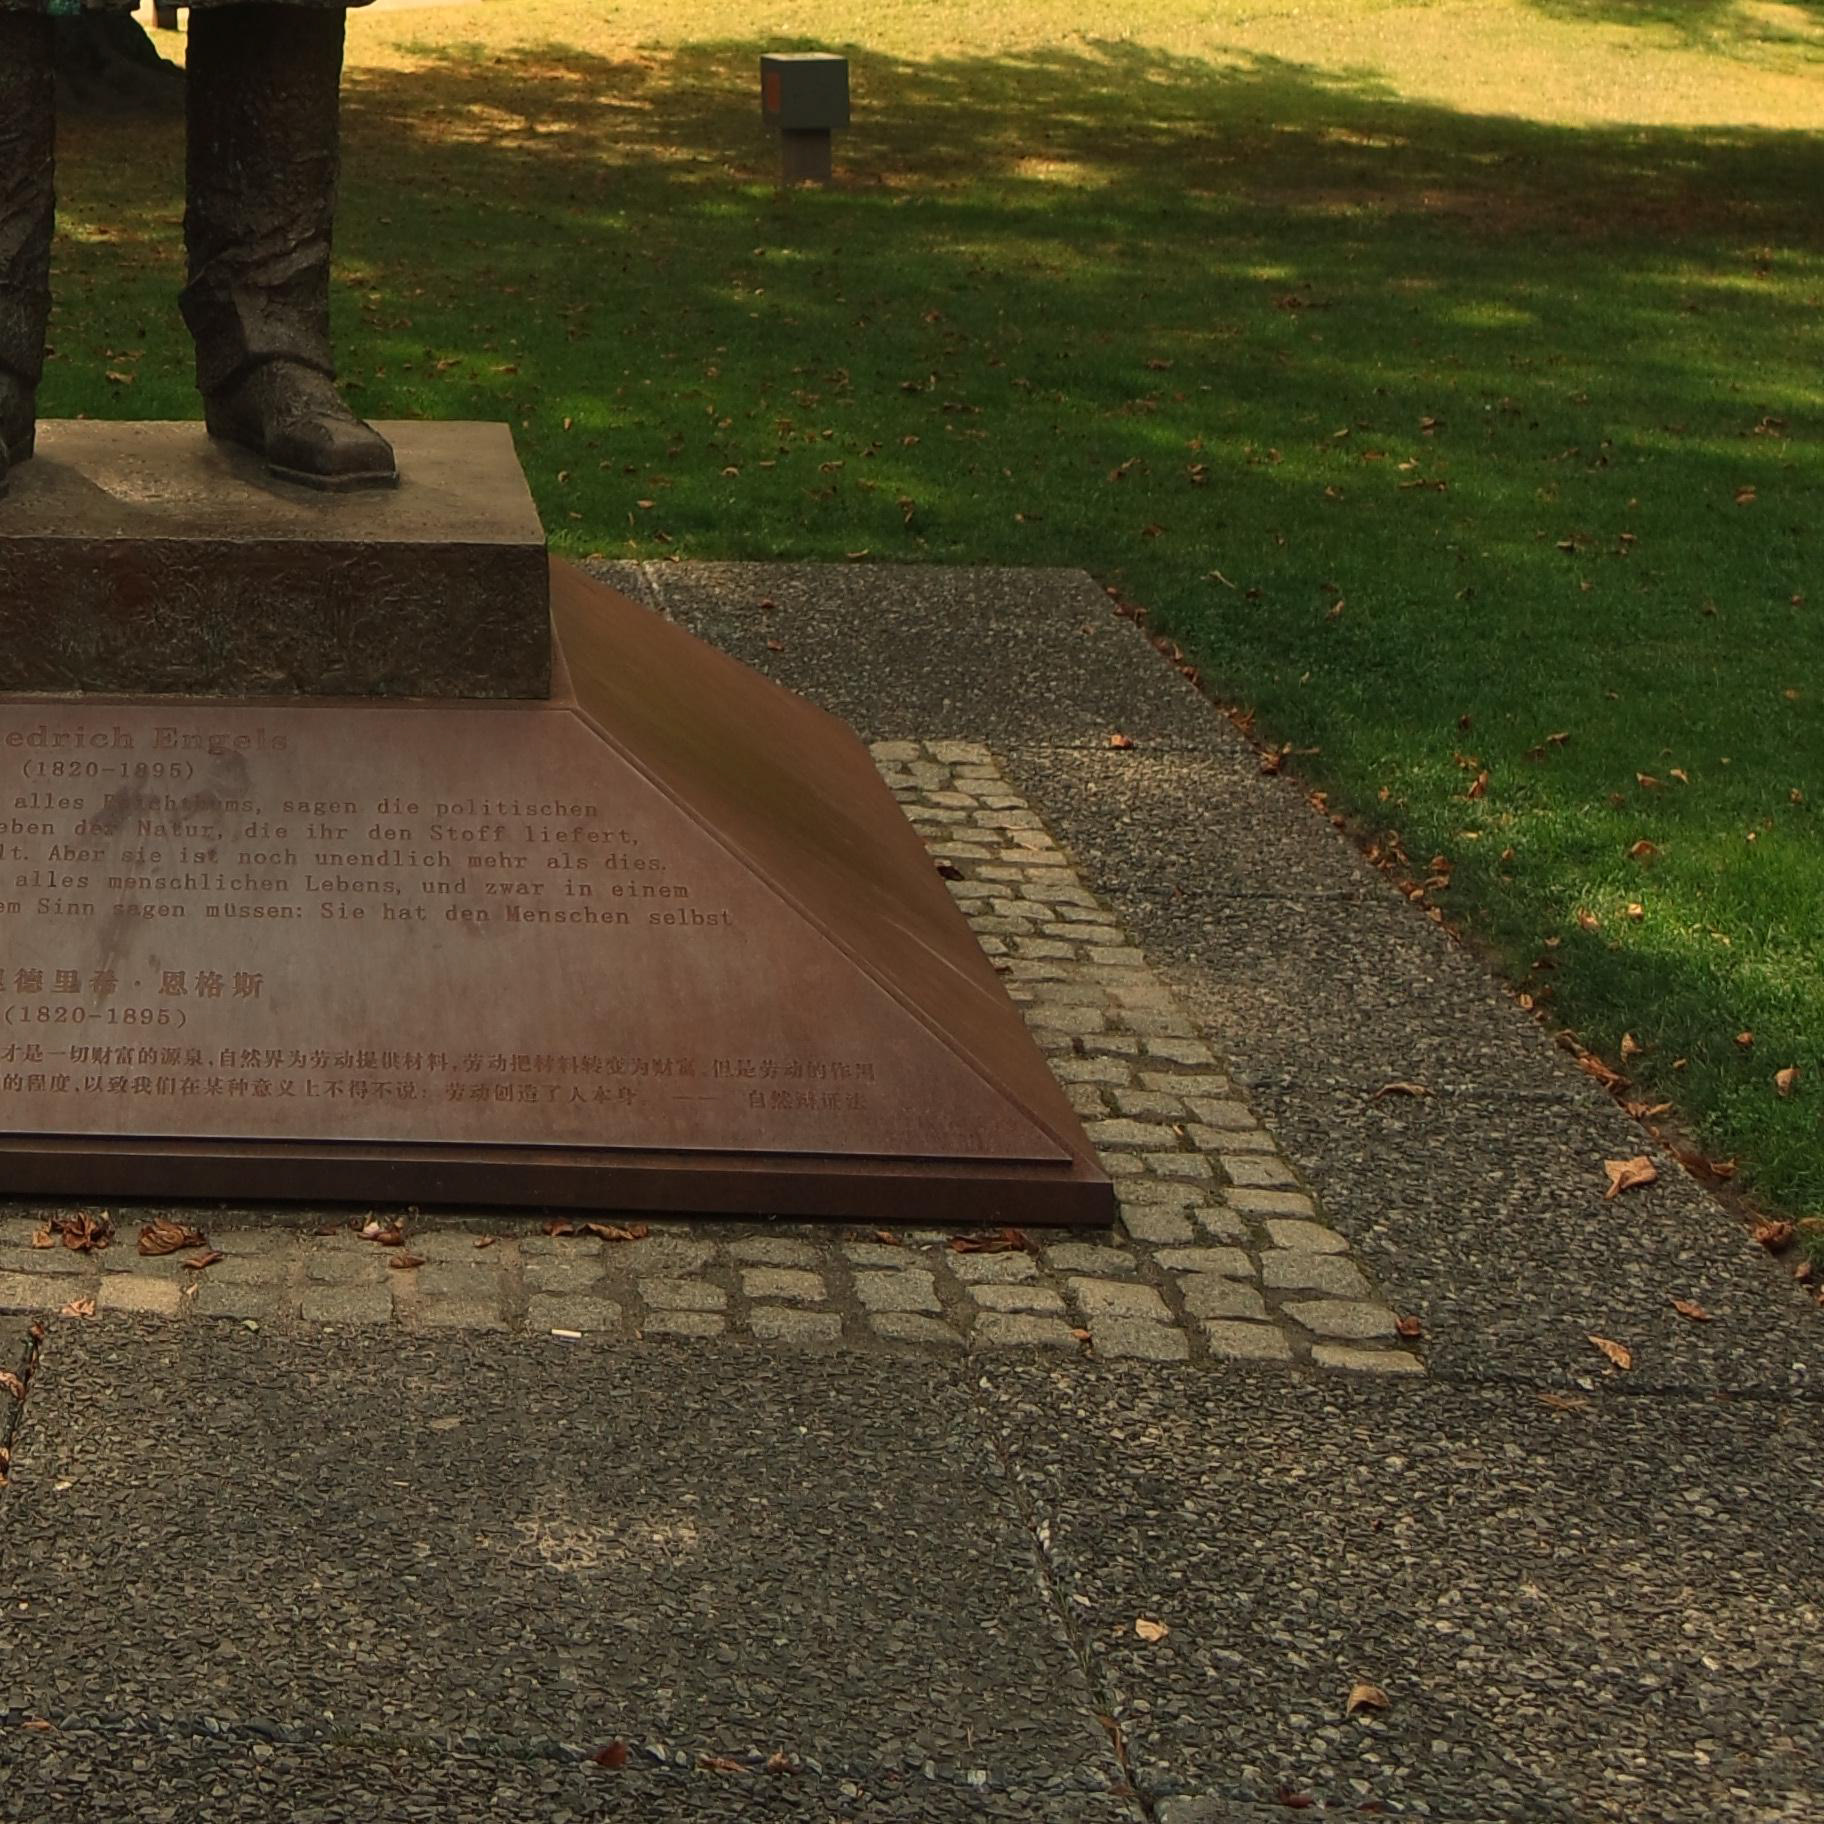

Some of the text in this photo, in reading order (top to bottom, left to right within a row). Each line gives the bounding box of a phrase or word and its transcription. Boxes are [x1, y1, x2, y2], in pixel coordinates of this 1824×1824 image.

[152, 727, 288, 756] Engels
[22, 759, 195, 781] (1820-1895)
[14, 793, 84, 811] alles
[283, 799, 357, 818] sagen
[378, 797, 419, 816] die
[435, 798, 598, 821] politischen
[74, 818, 117, 837] der
[137, 819, 223, 843] Natur,
[244, 821, 288, 840] die
[306, 822, 348, 841] ihr
[368, 823, 412, 841] den
[429, 823, 505, 843] Stoff
[525, 824, 640, 848] liefert,
[49, 844, 106, 863] Aber
[121, 845, 162, 864] sie
[179, 846, 218, 866] ist
[238, 847, 298, 867] noch
[316, 849, 451, 869] unendlich
[467, 851, 527, 870] mehr
[547, 852, 588, 871] als
[605, 853, 667, 873] dies.
[15, 873, 89, 891] alles
[107, 874, 288, 893] menschlichen
[304, 875, 403, 898] Lebens,
[422, 877, 465, 896] und
[486, 881, 545, 898] zwar
[565, 879, 592, 898] in
[612, 881, 689, 899] einem
[37, 898, 95, 916] Sinn
[112, 902, 185, 922] sagen
[206, 899, 302, 920] müssen:
[320, 903, 365, 921] Sie
[383, 904, 426, 923] hat
[445, 905, 489, 924] den
[505, 906, 630, 925] Menschen
[649, 908, 733, 927] selbst
[4, 1006, 187, 1030] (1820-1895)
